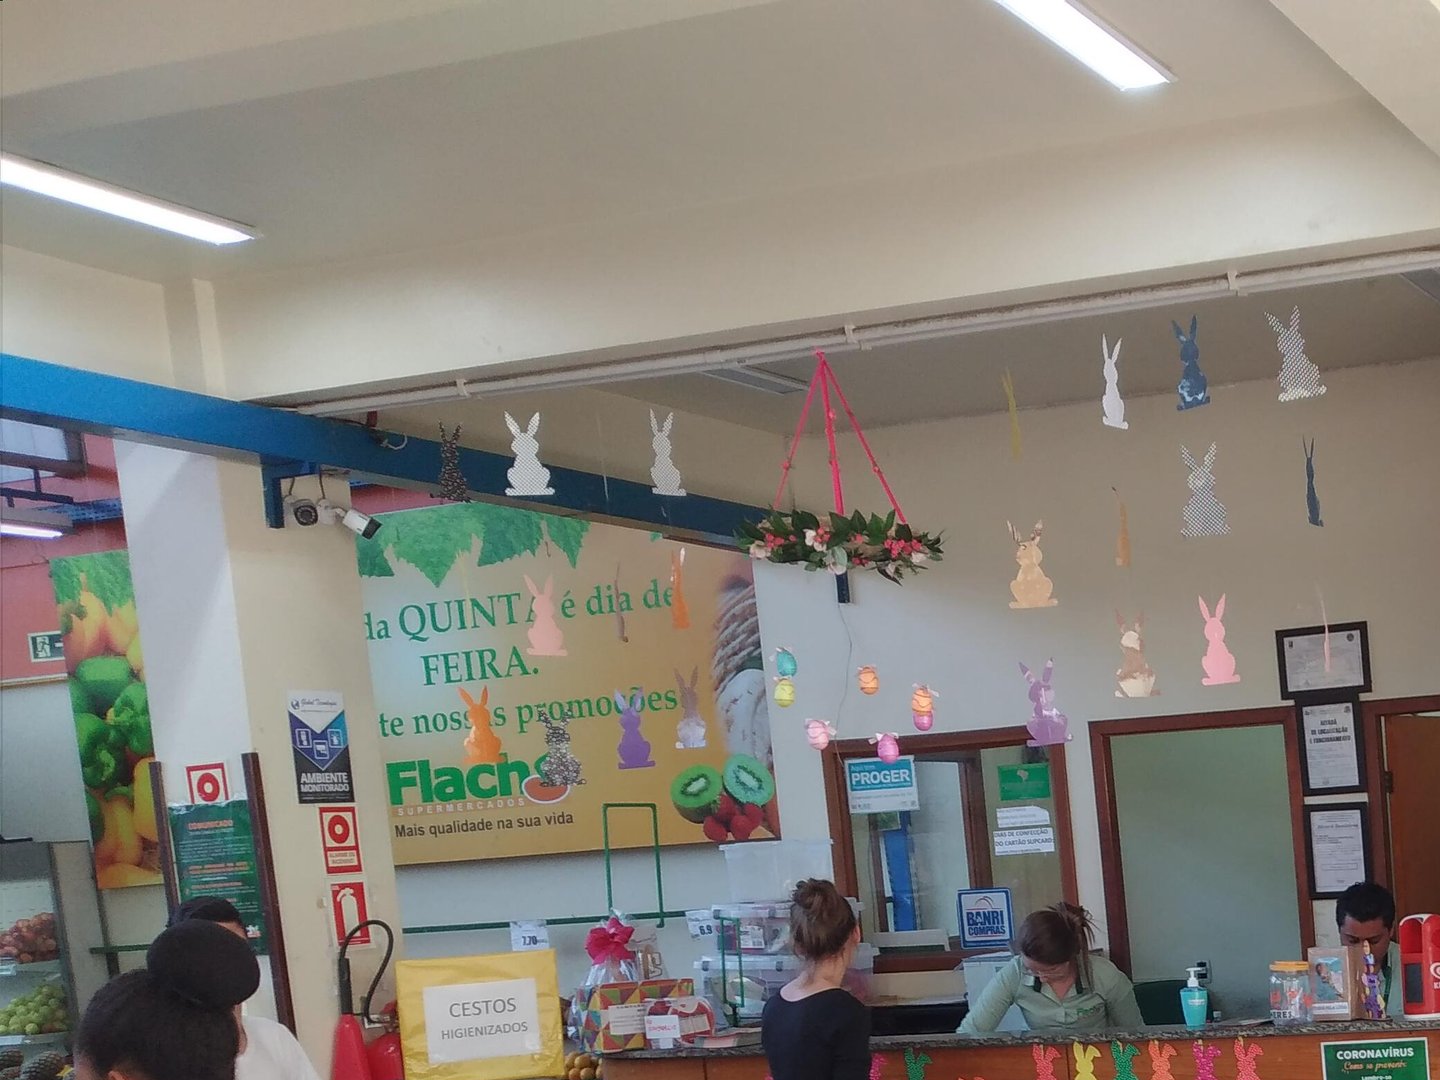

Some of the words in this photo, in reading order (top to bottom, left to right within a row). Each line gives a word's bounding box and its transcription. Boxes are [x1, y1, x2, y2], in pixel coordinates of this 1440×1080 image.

[560, 590, 576, 618] é
[585, 584, 634, 616] dia
[642, 578, 673, 609] de
[420, 645, 540, 687] FEIRA.
[413, 705, 507, 735] nosss
[301, 772, 349, 783] AMBIENTE
[851, 769, 911, 786] PROGER
[301, 783, 350, 793] MONITORADO
[397, 797, 526, 817] SUPERMERCADOS
[395, 823, 425, 838] Mais
[429, 818, 493, 836] qualidade
[497, 819, 514, 830] na
[517, 816, 542, 828] sua
[543, 811, 574, 826] vida
[966, 910, 1005, 927] BANRI
[968, 925, 1006, 937] COMPRAS
[450, 997, 518, 1019] CESTOS
[441, 1021, 529, 1040] HIGIENIZADOS
[1336, 1046, 1415, 1060] CORONAVÍRUS
